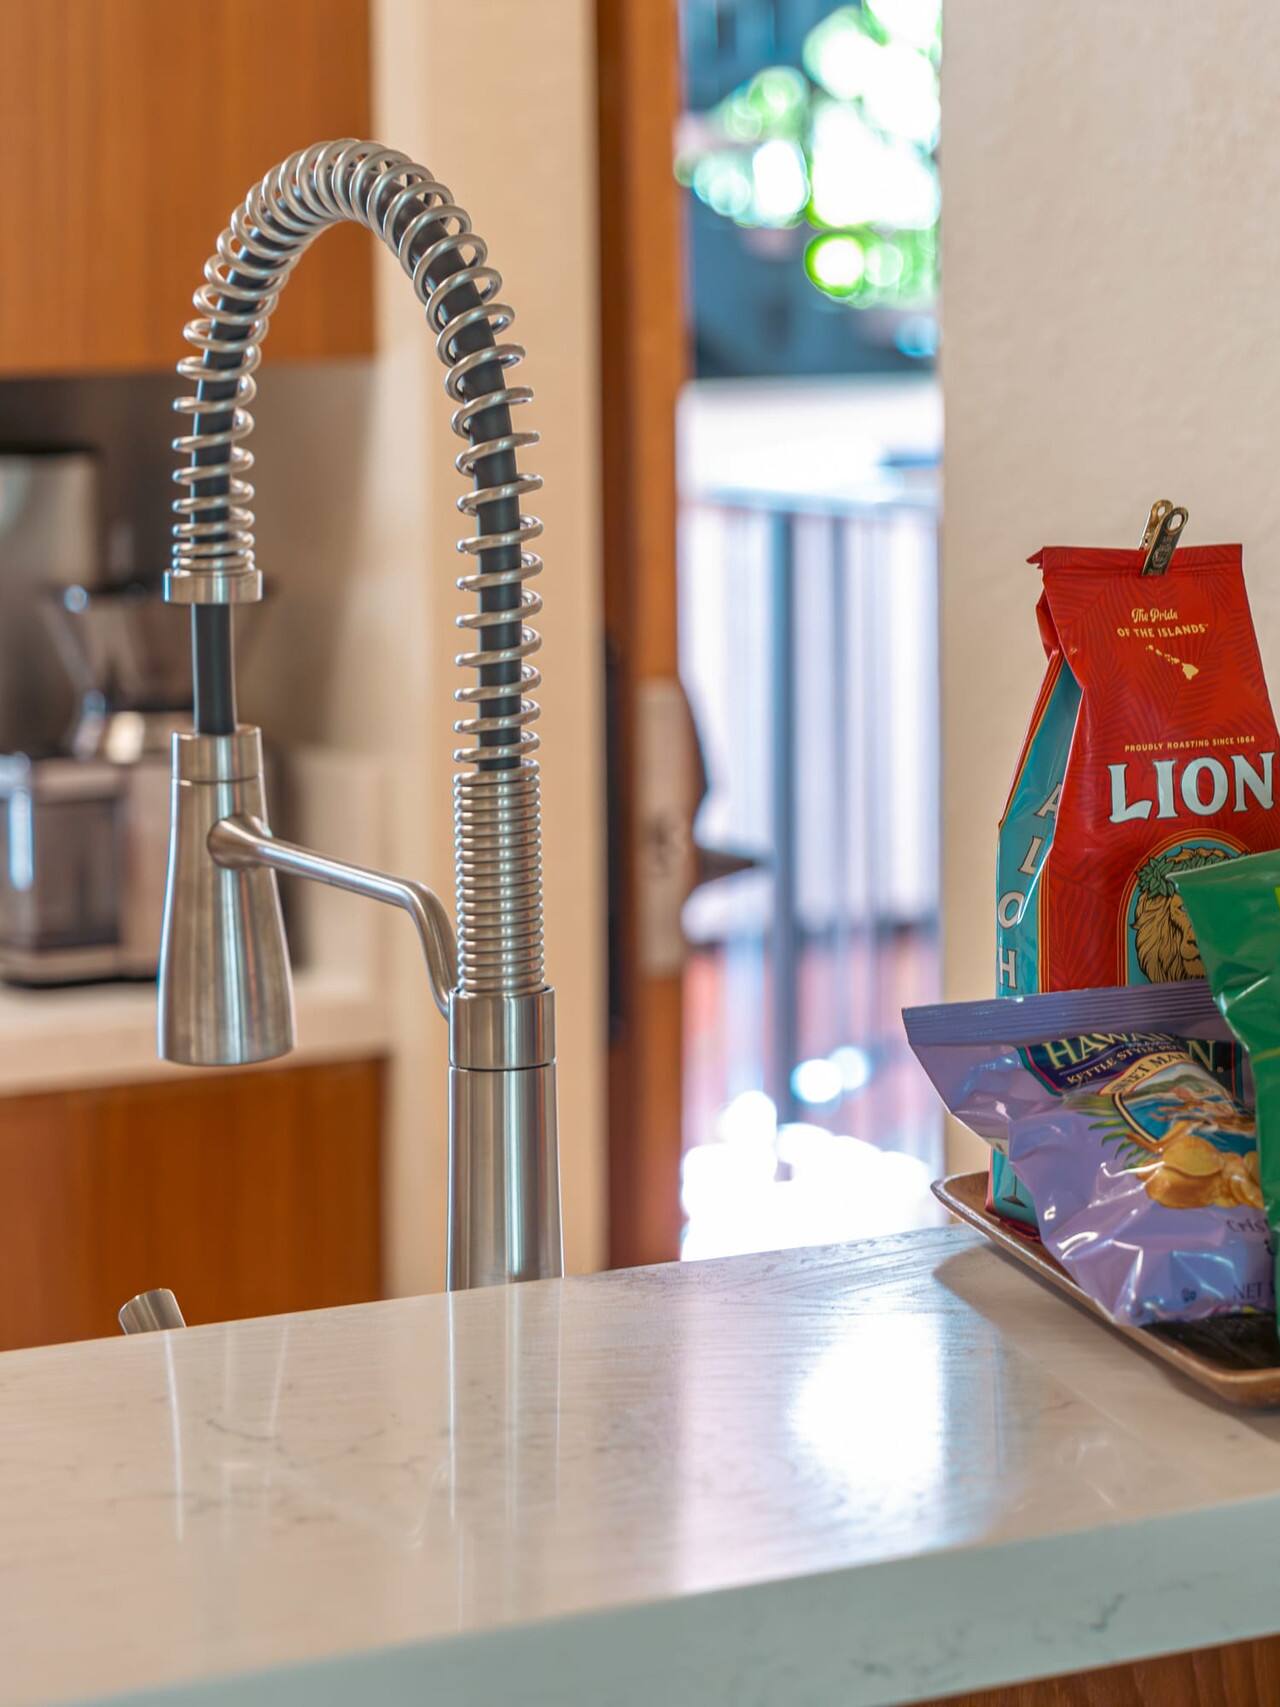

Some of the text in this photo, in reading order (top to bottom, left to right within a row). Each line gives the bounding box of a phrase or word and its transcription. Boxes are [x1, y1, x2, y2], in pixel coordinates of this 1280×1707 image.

[1131, 607, 1178, 623] The Pride
[1117, 628, 1130, 638] OF
[1134, 627, 1154, 638] THE
[1124, 742, 1163, 752] PROUDLY
[1167, 739, 1210, 749] ROASTING
[1212, 738, 1235, 746] SINCE
[1107, 751, 1275, 824] LION
